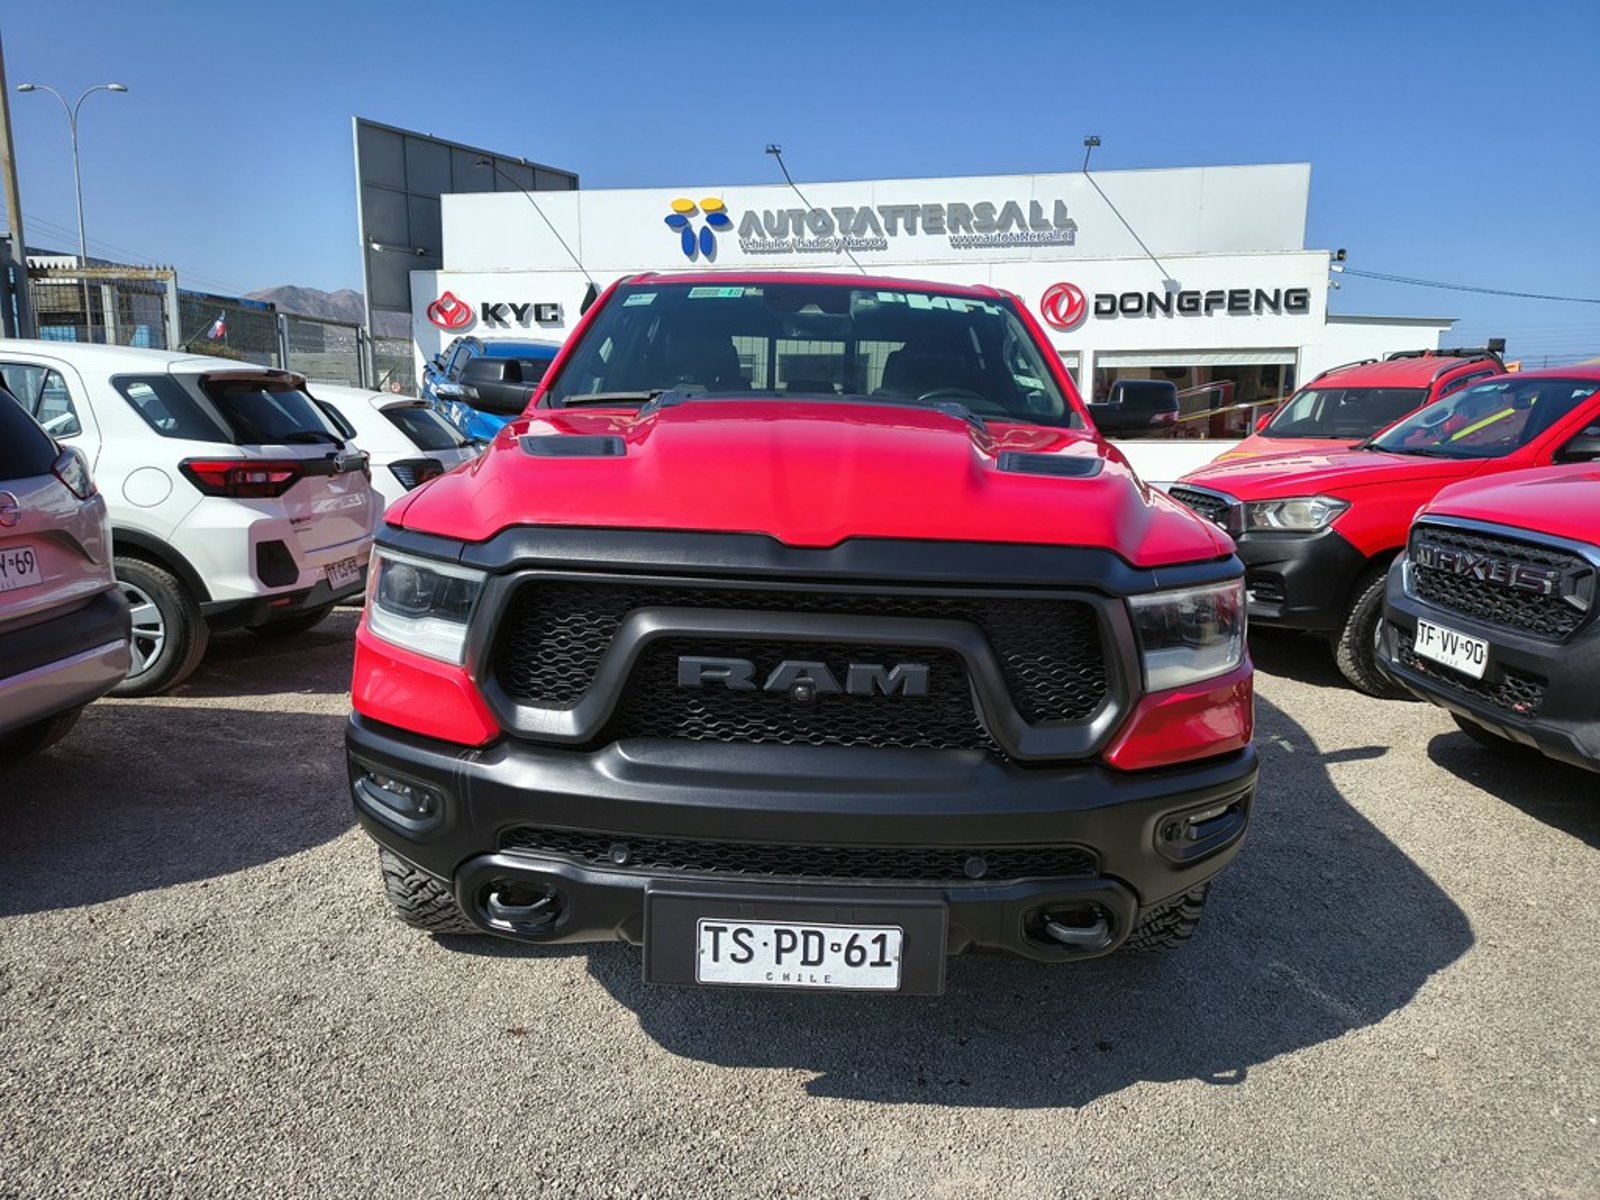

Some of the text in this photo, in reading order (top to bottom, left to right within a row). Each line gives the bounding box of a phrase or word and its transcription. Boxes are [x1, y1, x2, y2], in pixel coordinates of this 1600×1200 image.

[738, 200, 1077, 238] AUTOTATTERSALL
[792, 237, 832, 251] Usados
[842, 235, 886, 250] Nuevos
[1094, 288, 1310, 316] DONGFENG
[1418, 543, 1555, 595] MAXUS
[678, 655, 930, 696] RAM
[765, 971, 832, 984] CHILE
